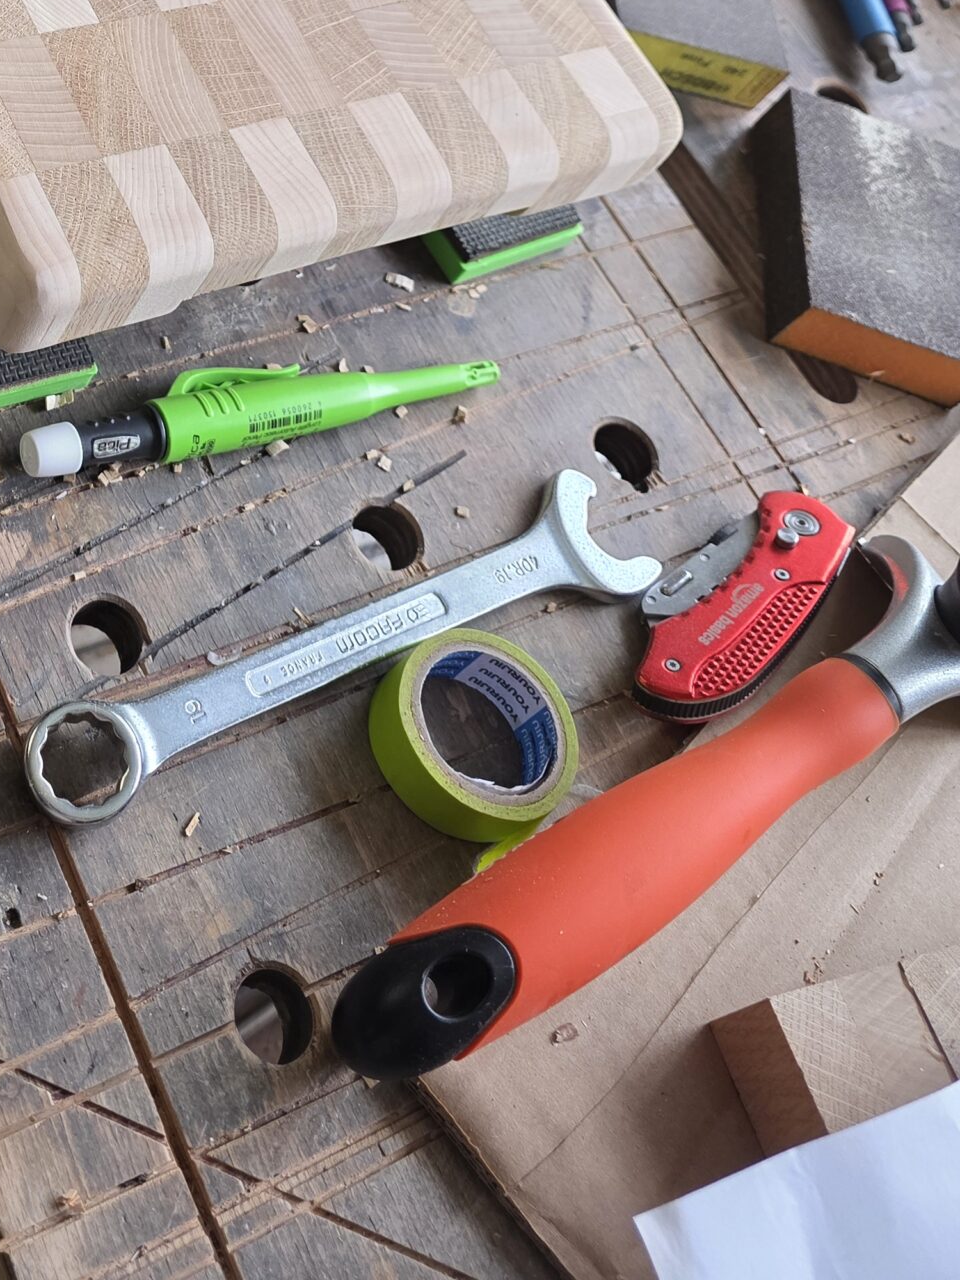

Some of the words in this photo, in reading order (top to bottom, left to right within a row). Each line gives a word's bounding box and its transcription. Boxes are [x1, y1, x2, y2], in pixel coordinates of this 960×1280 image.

[248, 410, 277, 423] 150371
[281, 402, 312, 416] 260056
[96, 436, 132, 453] Pica
[725, 582, 765, 618] amazon
[336, 610, 405, 654] FACOM
[697, 613, 735, 646] basics
[281, 651, 325, 678] FRANCE
